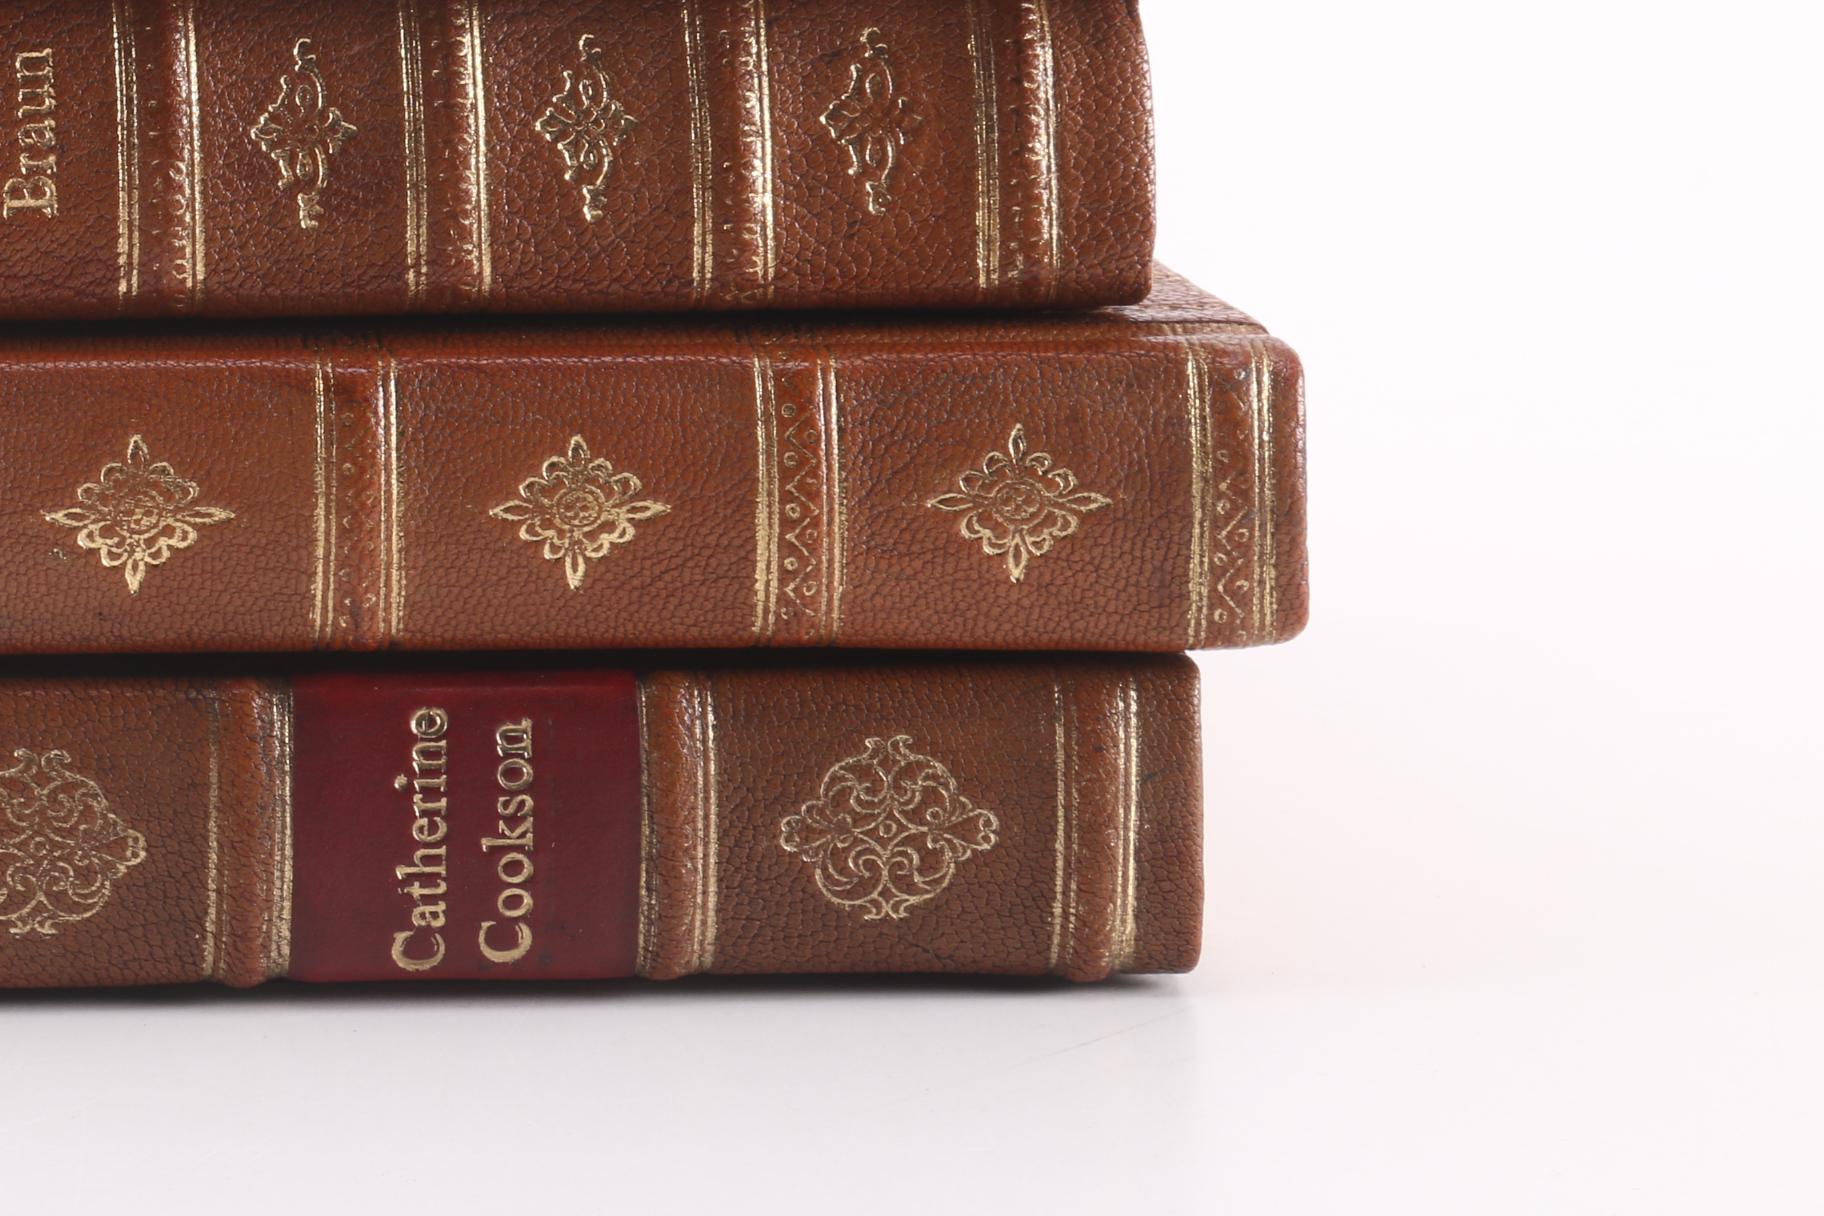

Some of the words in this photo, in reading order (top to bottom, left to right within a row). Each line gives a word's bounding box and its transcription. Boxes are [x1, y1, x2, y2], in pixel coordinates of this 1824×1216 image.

[3, 47, 59, 220] Braun
[391, 706, 449, 972] Catherine
[478, 717, 535, 964] Cookson
